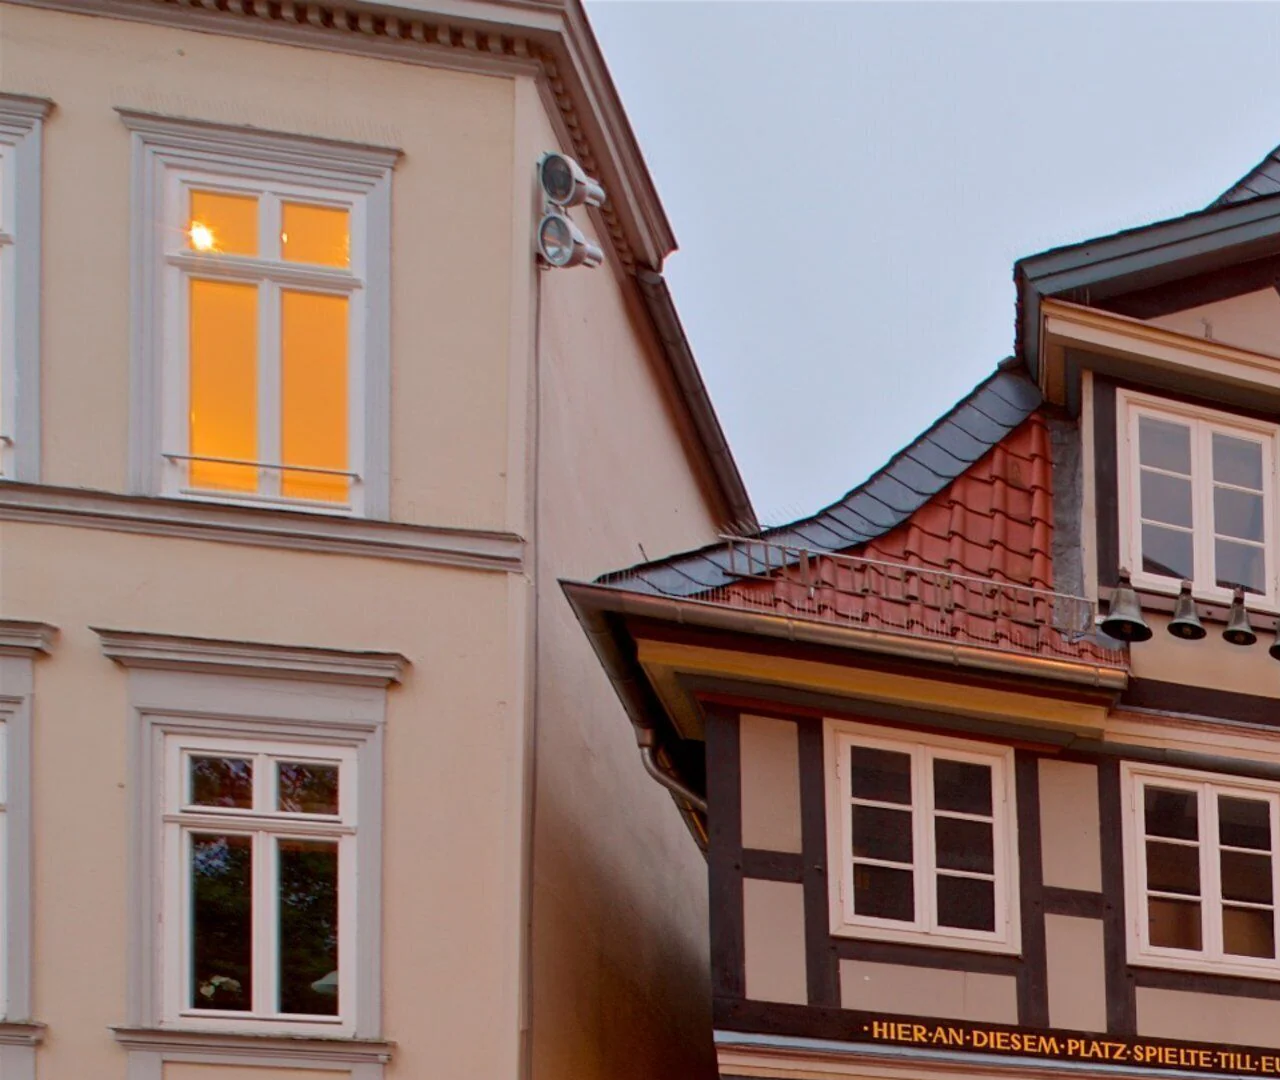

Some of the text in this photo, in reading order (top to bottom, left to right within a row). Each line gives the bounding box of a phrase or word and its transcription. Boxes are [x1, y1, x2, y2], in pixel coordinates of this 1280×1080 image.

[872, 1021, 927, 1043] HIER
[932, 1026, 964, 1045] AN
[973, 1030, 1059, 1055] DIESEM
[1067, 1039, 1127, 1060] PLATZ
[1134, 1044, 1213, 1068] SPIELTE
[1216, 1051, 1256, 1070] TILL
